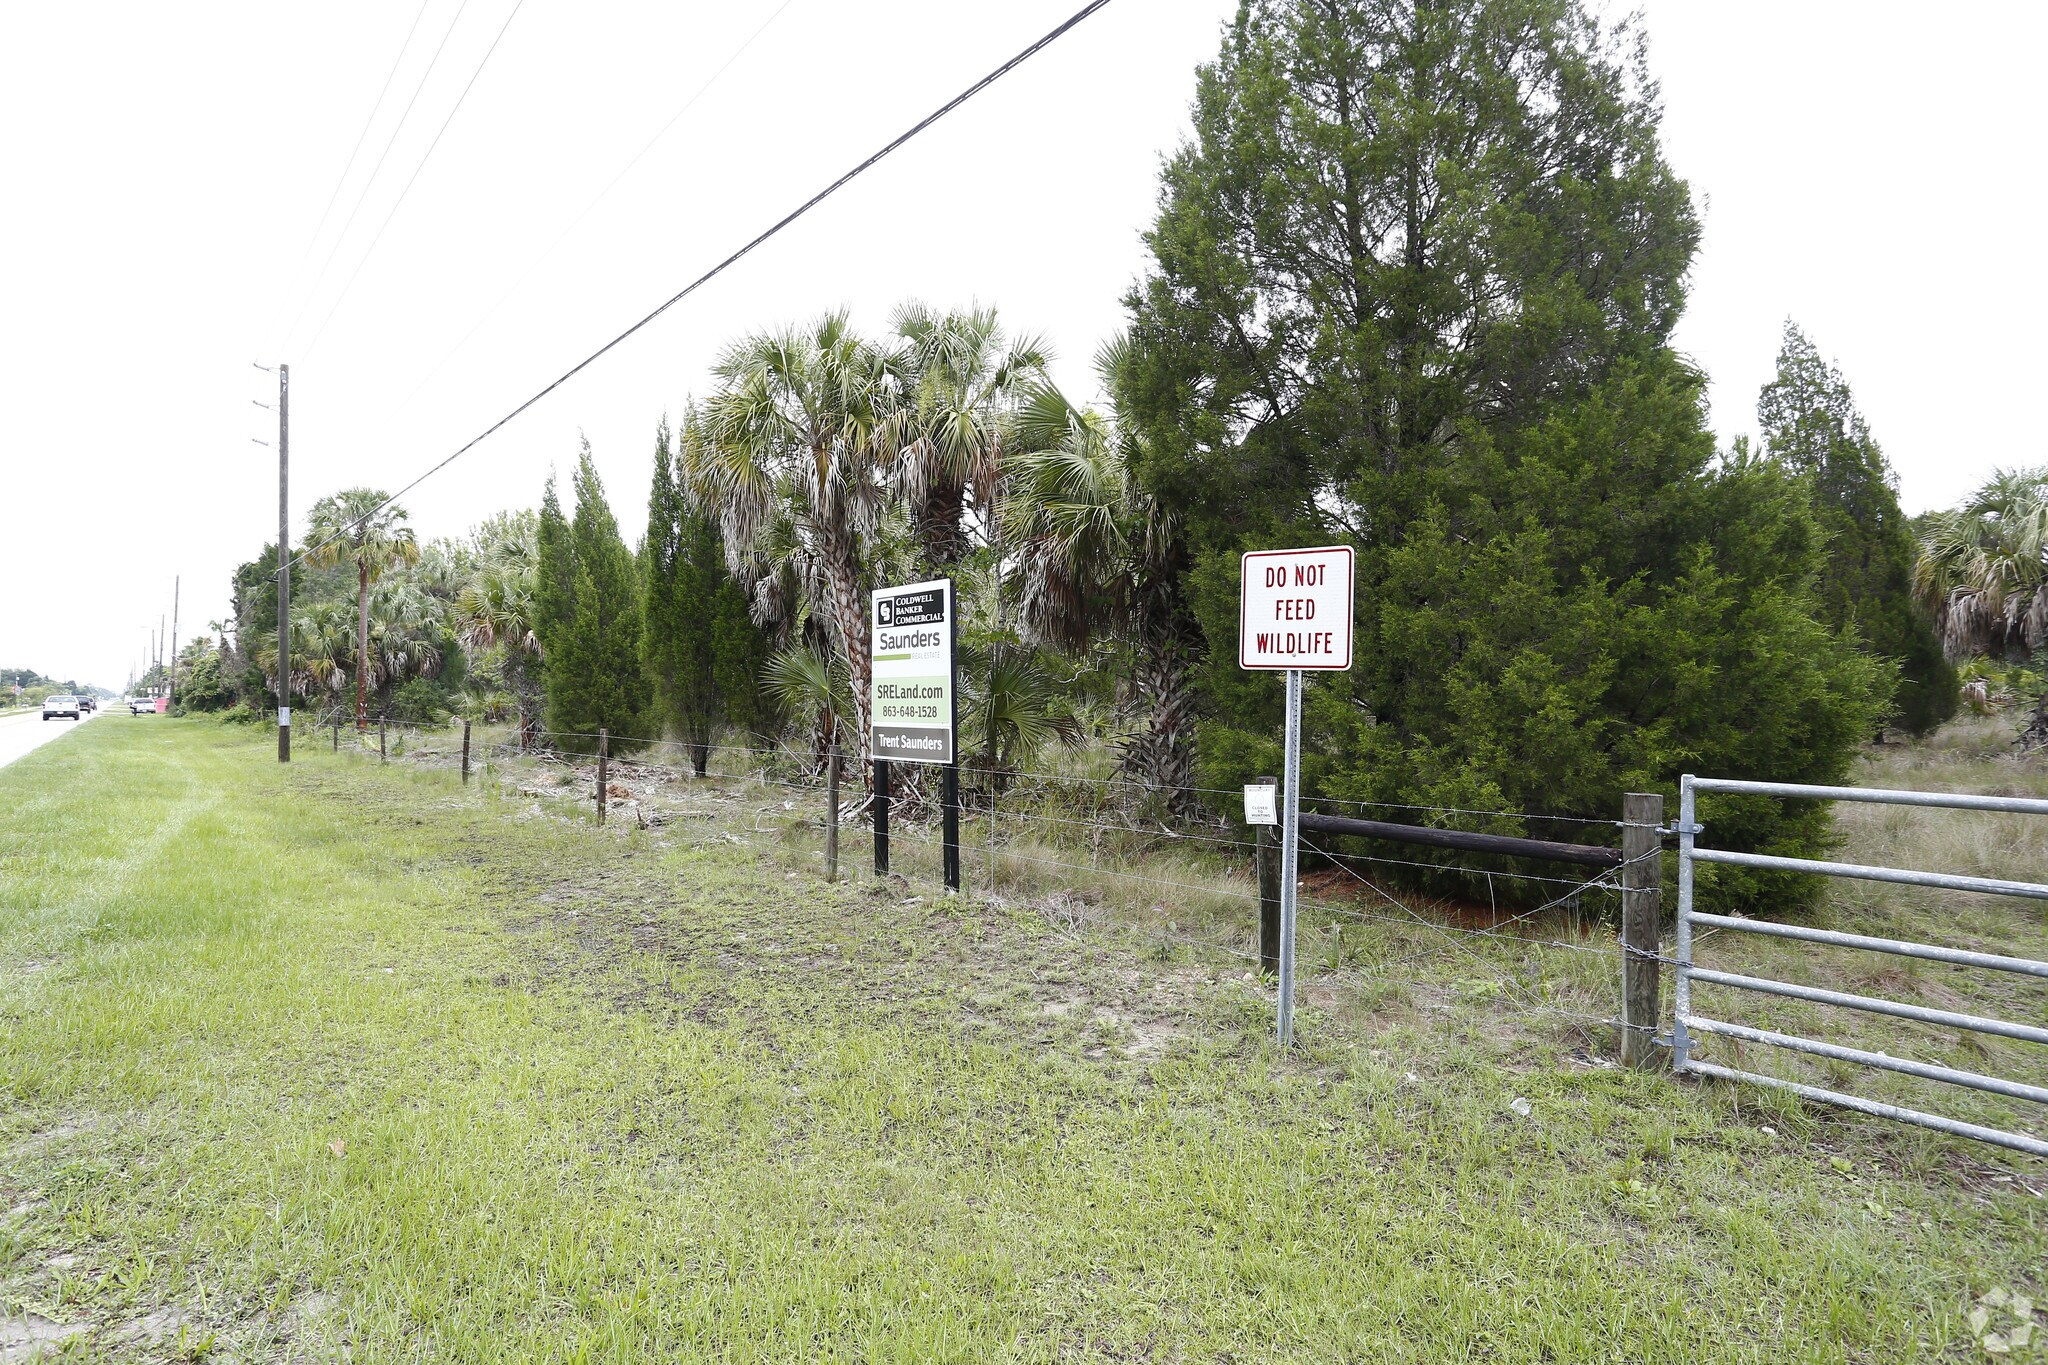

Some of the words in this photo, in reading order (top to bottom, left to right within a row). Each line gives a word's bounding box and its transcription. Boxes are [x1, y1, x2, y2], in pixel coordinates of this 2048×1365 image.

[1266, 566, 1286, 588] DO
[1295, 564, 1326, 587] NOT
[895, 594, 934, 606] COLDWELL
[895, 605, 923, 615] BANKER
[1276, 598, 1315, 620] FEED
[895, 612, 943, 625] COMMERCIAL
[879, 629, 941, 651] Saunders
[1257, 632, 1333, 654] WILDLIFE
[877, 684, 943, 699] SRELand.com
[882, 705, 937, 718] 863-648-1528
[878, 733, 900, 748] Trent
[900, 734, 943, 751] Saunders
